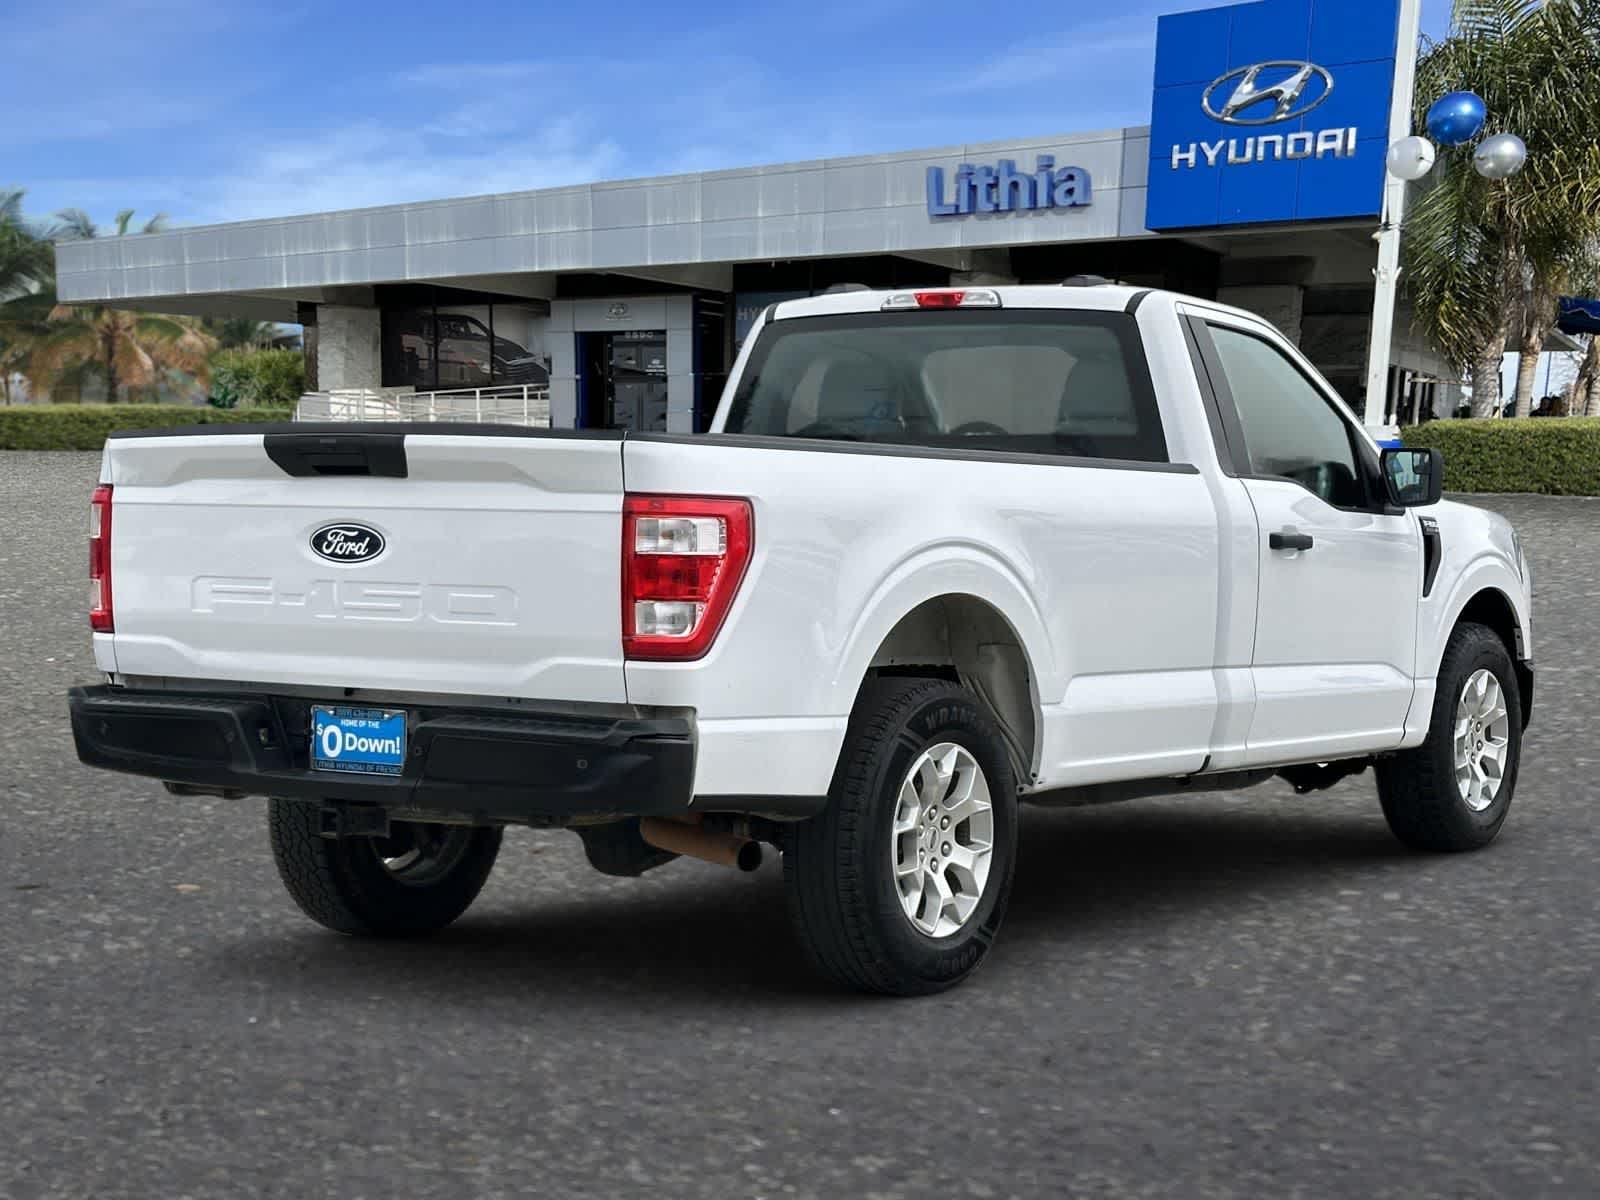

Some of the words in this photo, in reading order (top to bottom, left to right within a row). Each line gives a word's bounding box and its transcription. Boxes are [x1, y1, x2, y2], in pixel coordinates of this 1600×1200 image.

[1171, 127, 1357, 170] HYUNDAI
[926, 155, 1093, 218] Lithia
[322, 528, 369, 557] Ford
[191, 575, 518, 626] F-150
[341, 719, 358, 728] HOME
[359, 720, 367, 728] OF
[368, 721, 380, 729] THE
[345, 733, 400, 755] Down!
